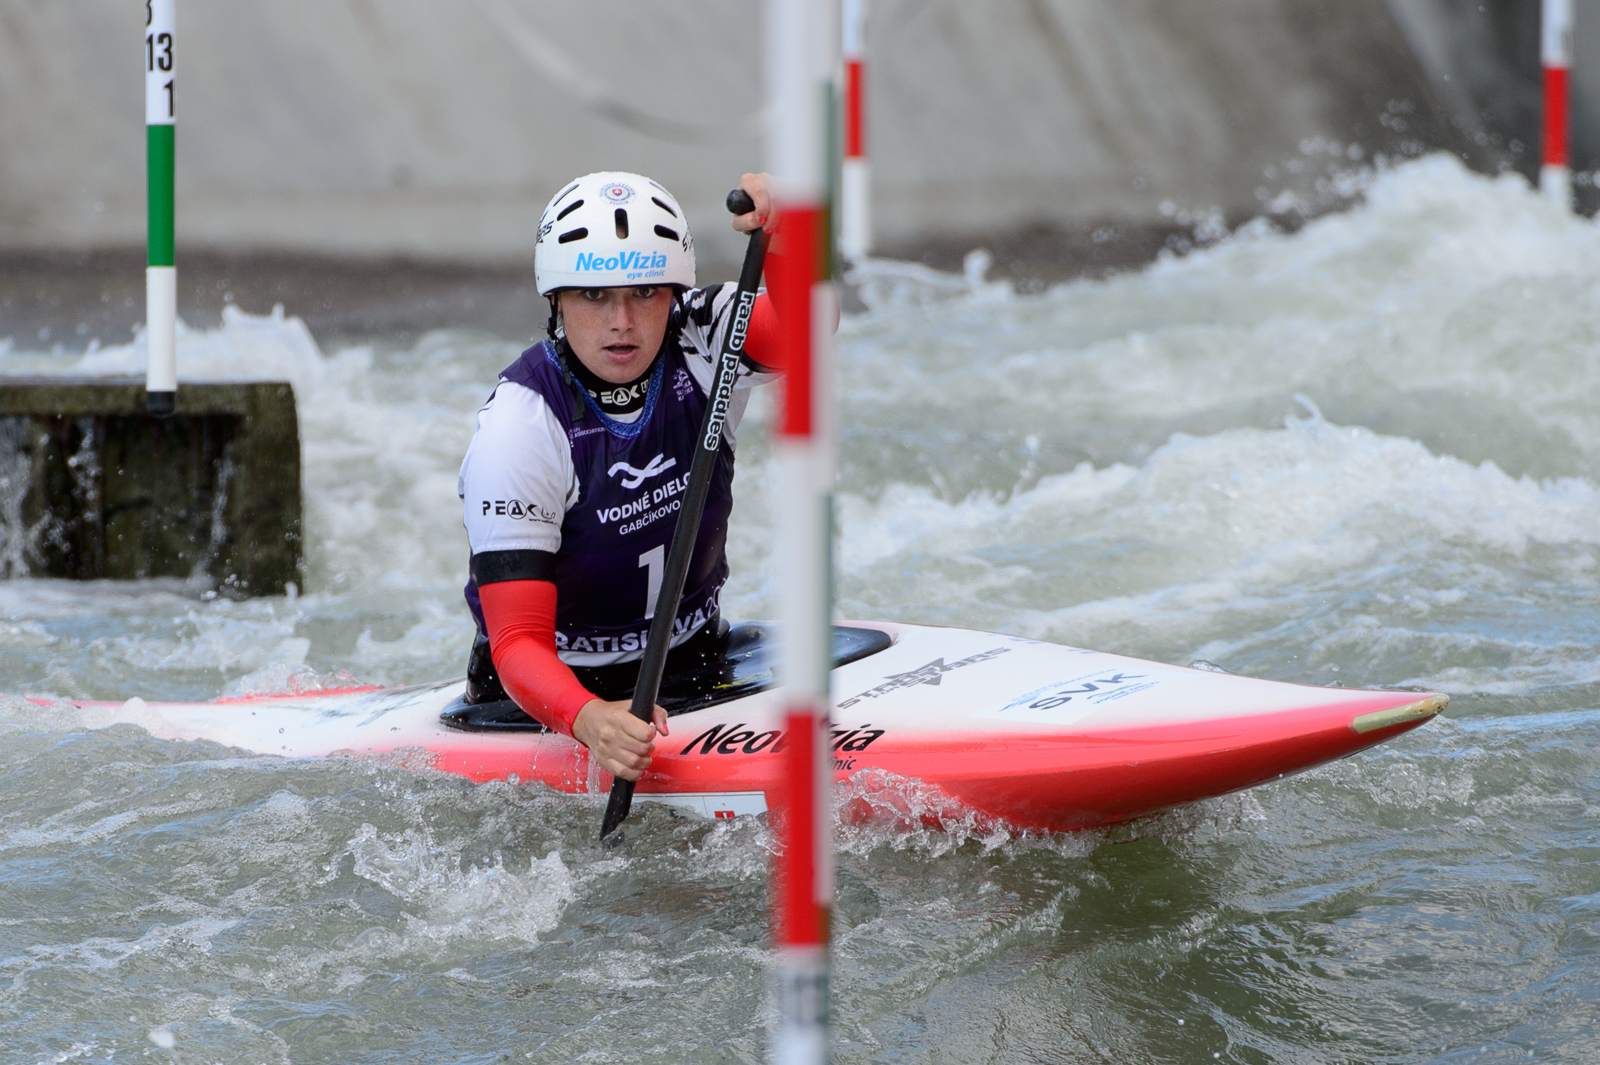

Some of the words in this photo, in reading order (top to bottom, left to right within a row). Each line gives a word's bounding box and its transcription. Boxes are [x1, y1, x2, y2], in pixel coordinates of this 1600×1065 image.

[146, 33, 173, 72] 13
[626, 272, 643, 281] eye
[644, 269, 666, 278] clinic
[729, 291, 756, 351] raab
[703, 353, 740, 451] paddles
[482, 499, 538, 520] PEAK
[596, 490, 651, 524] VODNÉ
[619, 499, 681, 535] GABČÍKOVO
[638, 544, 666, 620] 1
[1028, 672, 1151, 710] SVK
